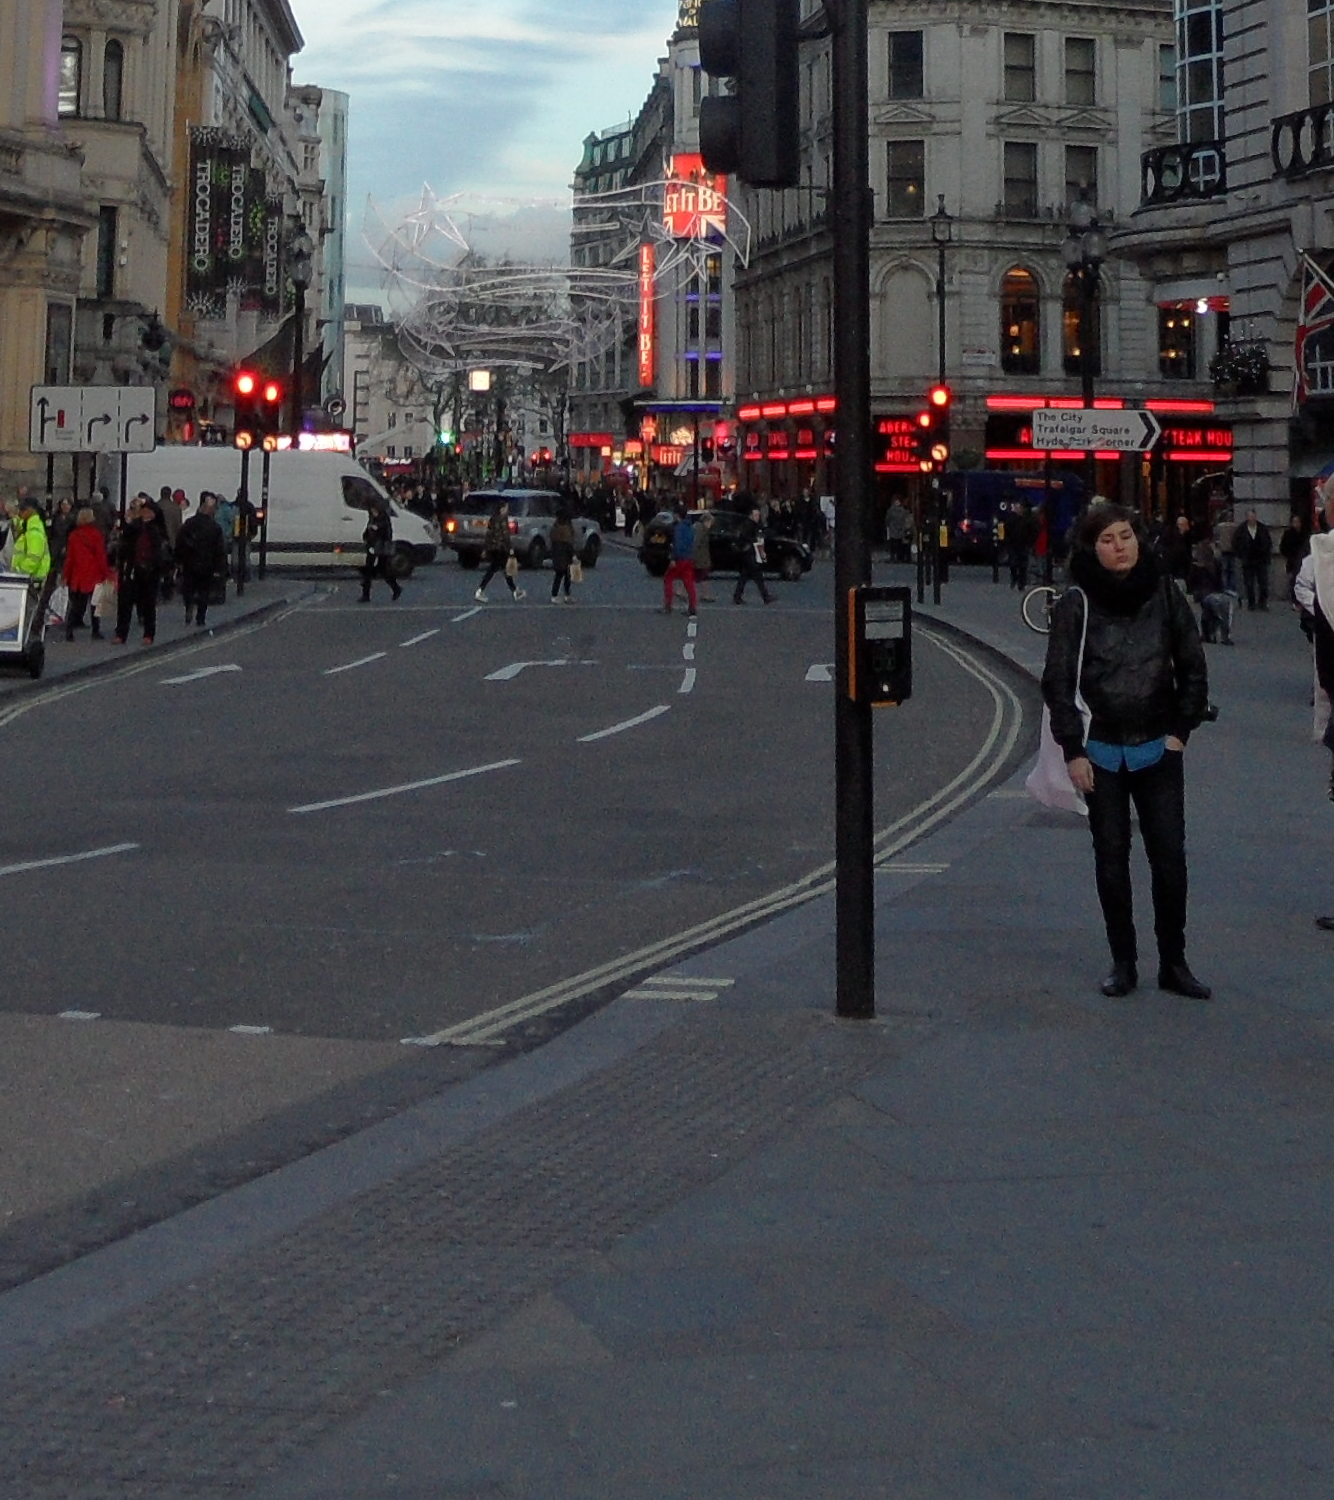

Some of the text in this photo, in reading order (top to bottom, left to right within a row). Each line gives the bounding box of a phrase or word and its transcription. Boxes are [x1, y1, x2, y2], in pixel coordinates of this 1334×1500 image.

[681, 187, 696, 212] IT
[698, 186, 723, 212] BE
[194, 159, 211, 271] TROCADERO
[229, 164, 245, 259] TROCADERO
[267, 216, 279, 295] TROCADERO
[1037, 411, 1083, 423] The City
[879, 421, 916, 434] ABER
[1037, 423, 1131, 435] Trafalgar Square
[1036, 436, 1064, 447] Hyde
